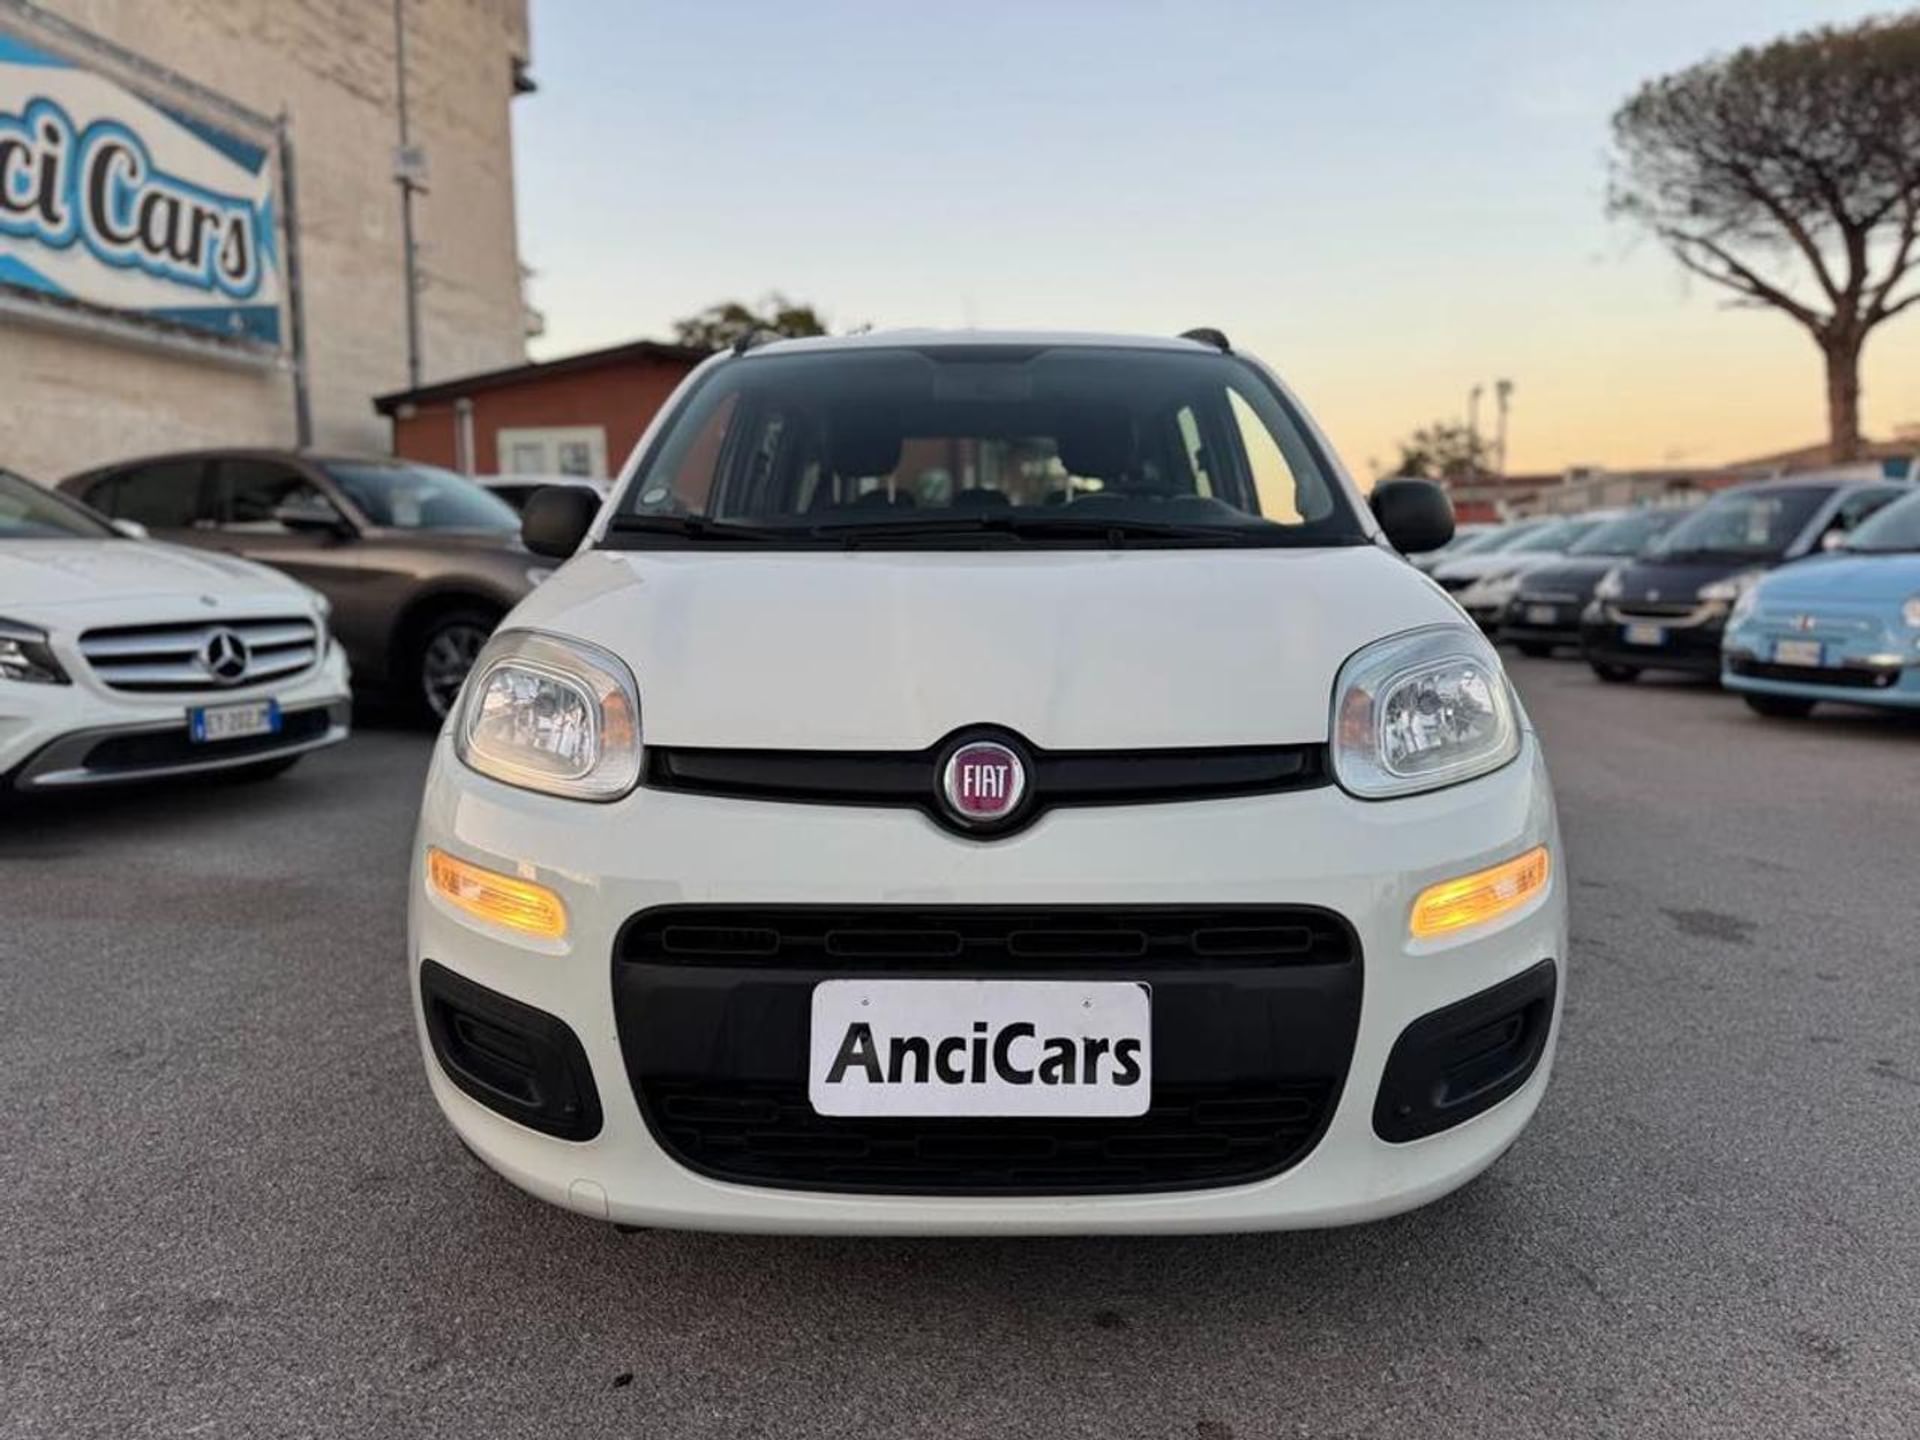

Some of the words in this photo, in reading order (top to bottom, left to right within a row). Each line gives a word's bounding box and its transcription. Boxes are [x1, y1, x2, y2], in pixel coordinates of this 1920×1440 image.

[89, 144, 247, 279] Cars
[963, 764, 1009, 798] FIAT
[825, 1021, 1142, 1086] AnciCars
